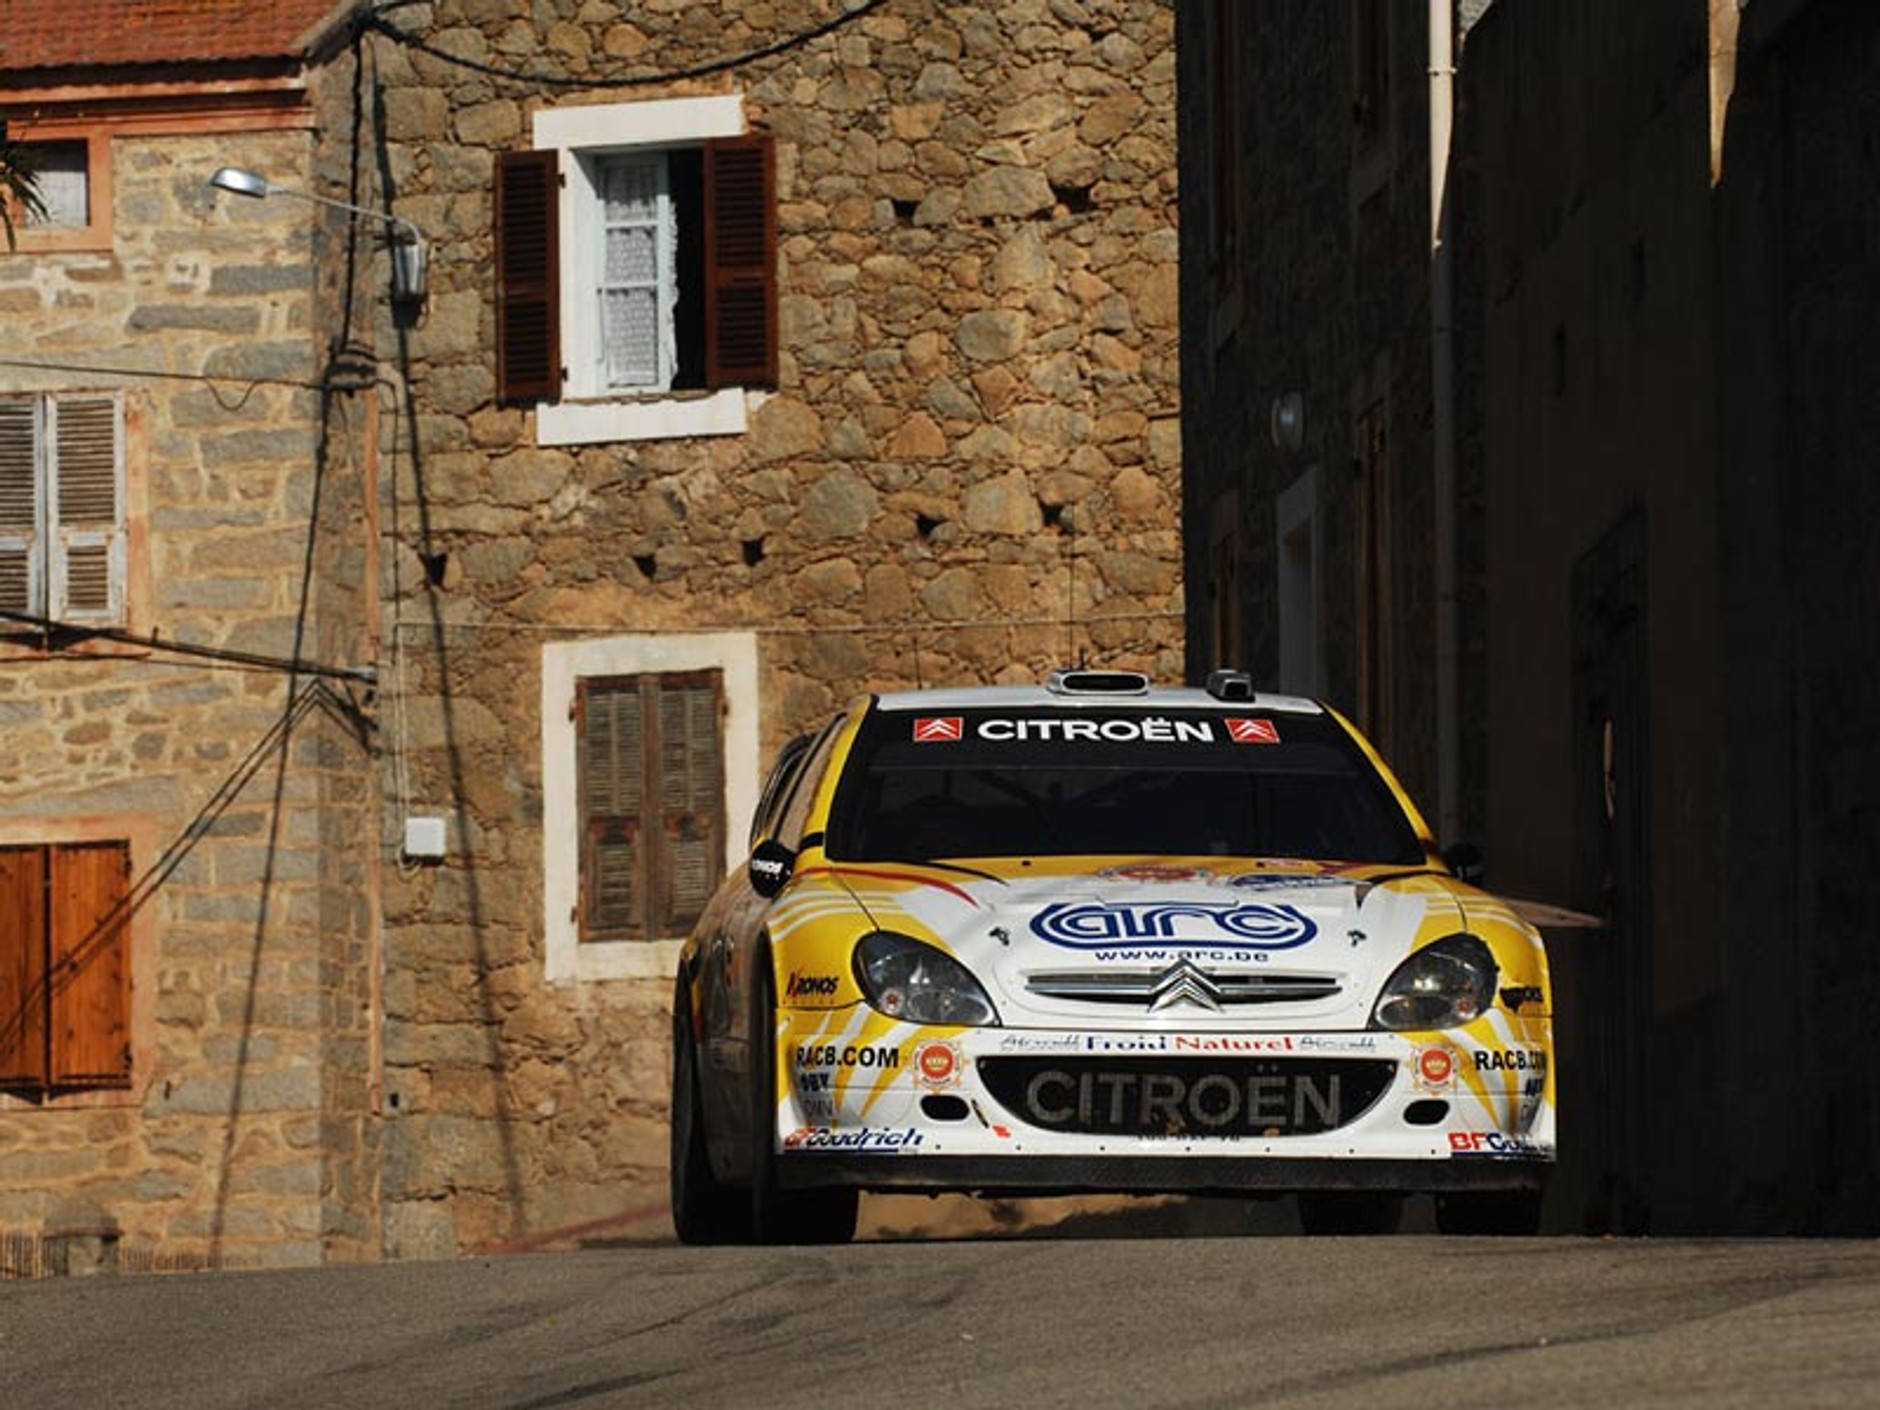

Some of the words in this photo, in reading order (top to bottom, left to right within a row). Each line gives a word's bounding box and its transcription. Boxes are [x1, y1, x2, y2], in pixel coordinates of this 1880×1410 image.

[977, 716, 1214, 743] CITROËN
[1175, 1036, 1294, 1050] Naturel
[796, 1046, 899, 1068] RACB.COM
[1026, 1064, 1341, 1127] CITROËN
